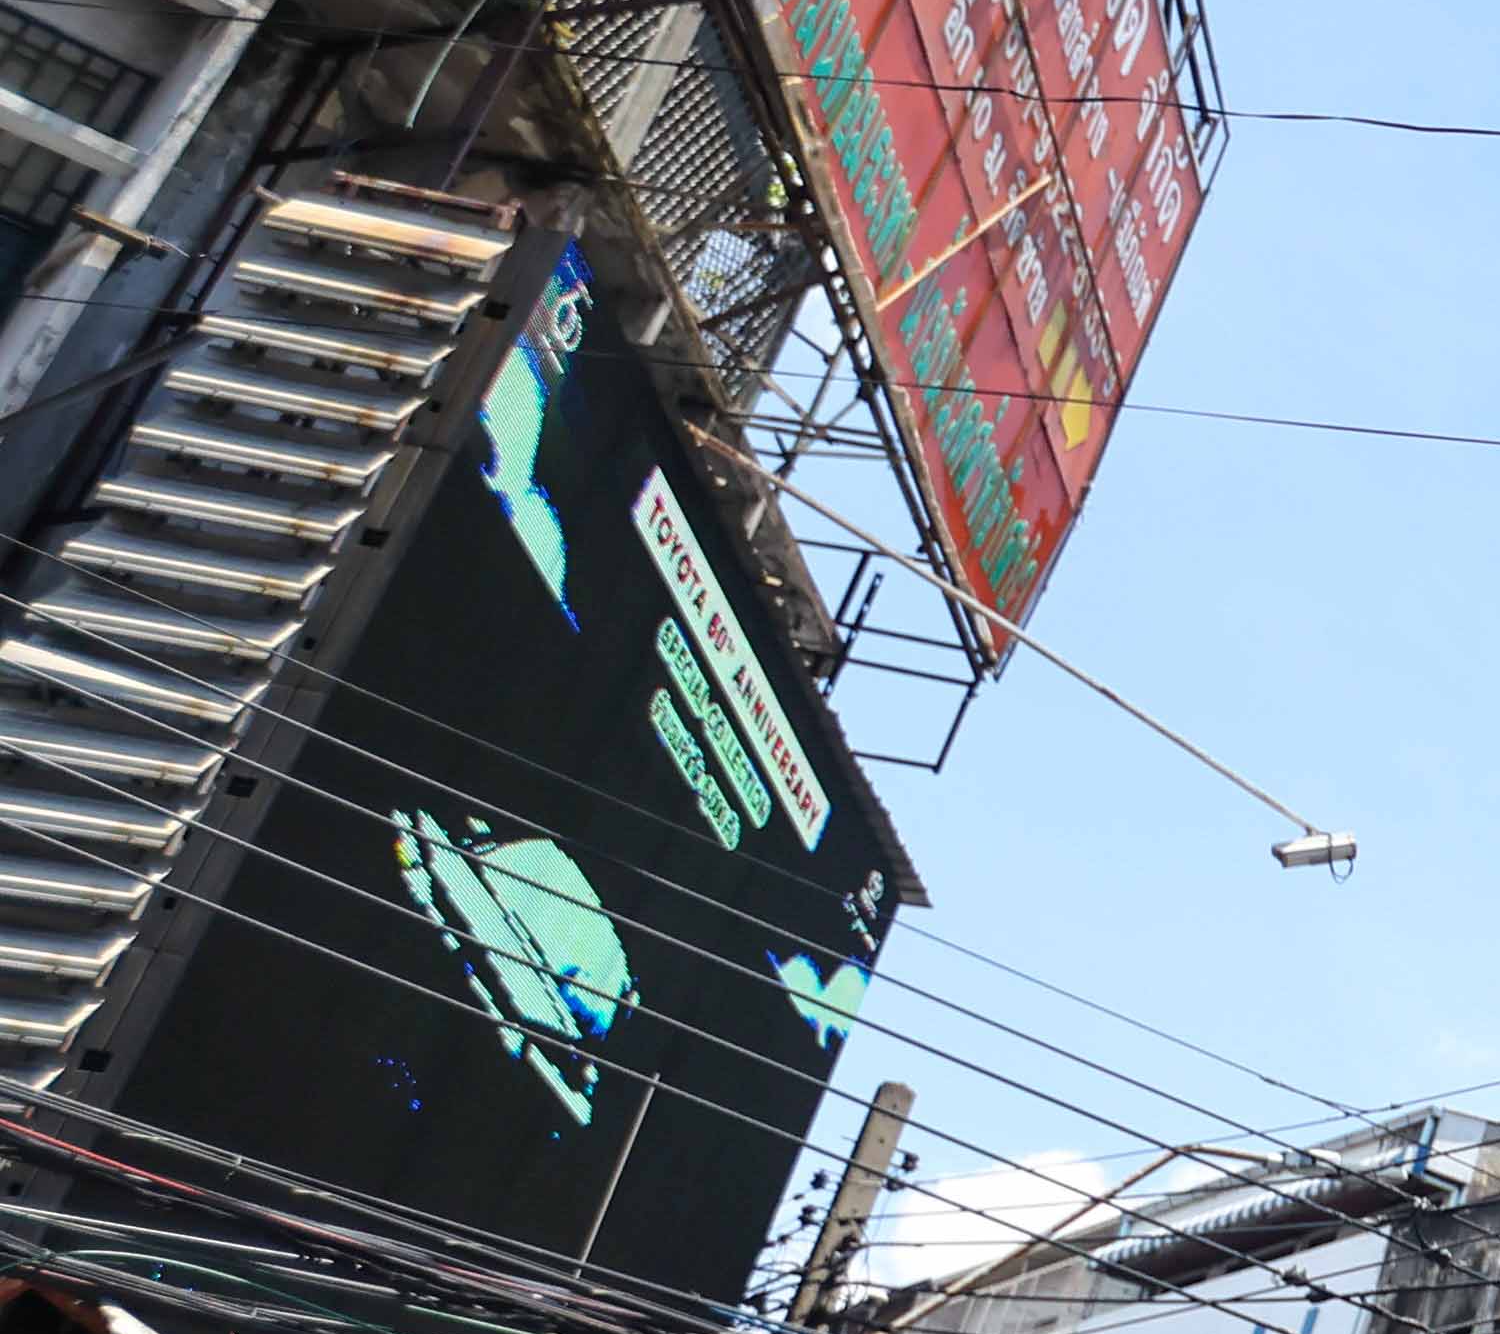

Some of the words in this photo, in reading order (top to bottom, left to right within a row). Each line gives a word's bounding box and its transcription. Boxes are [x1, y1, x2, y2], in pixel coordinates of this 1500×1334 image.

[1134, 63, 1187, 248] จำกัด
[648, 493, 712, 618] TOYOTA
[733, 663, 821, 831] ANNIVERSARY
